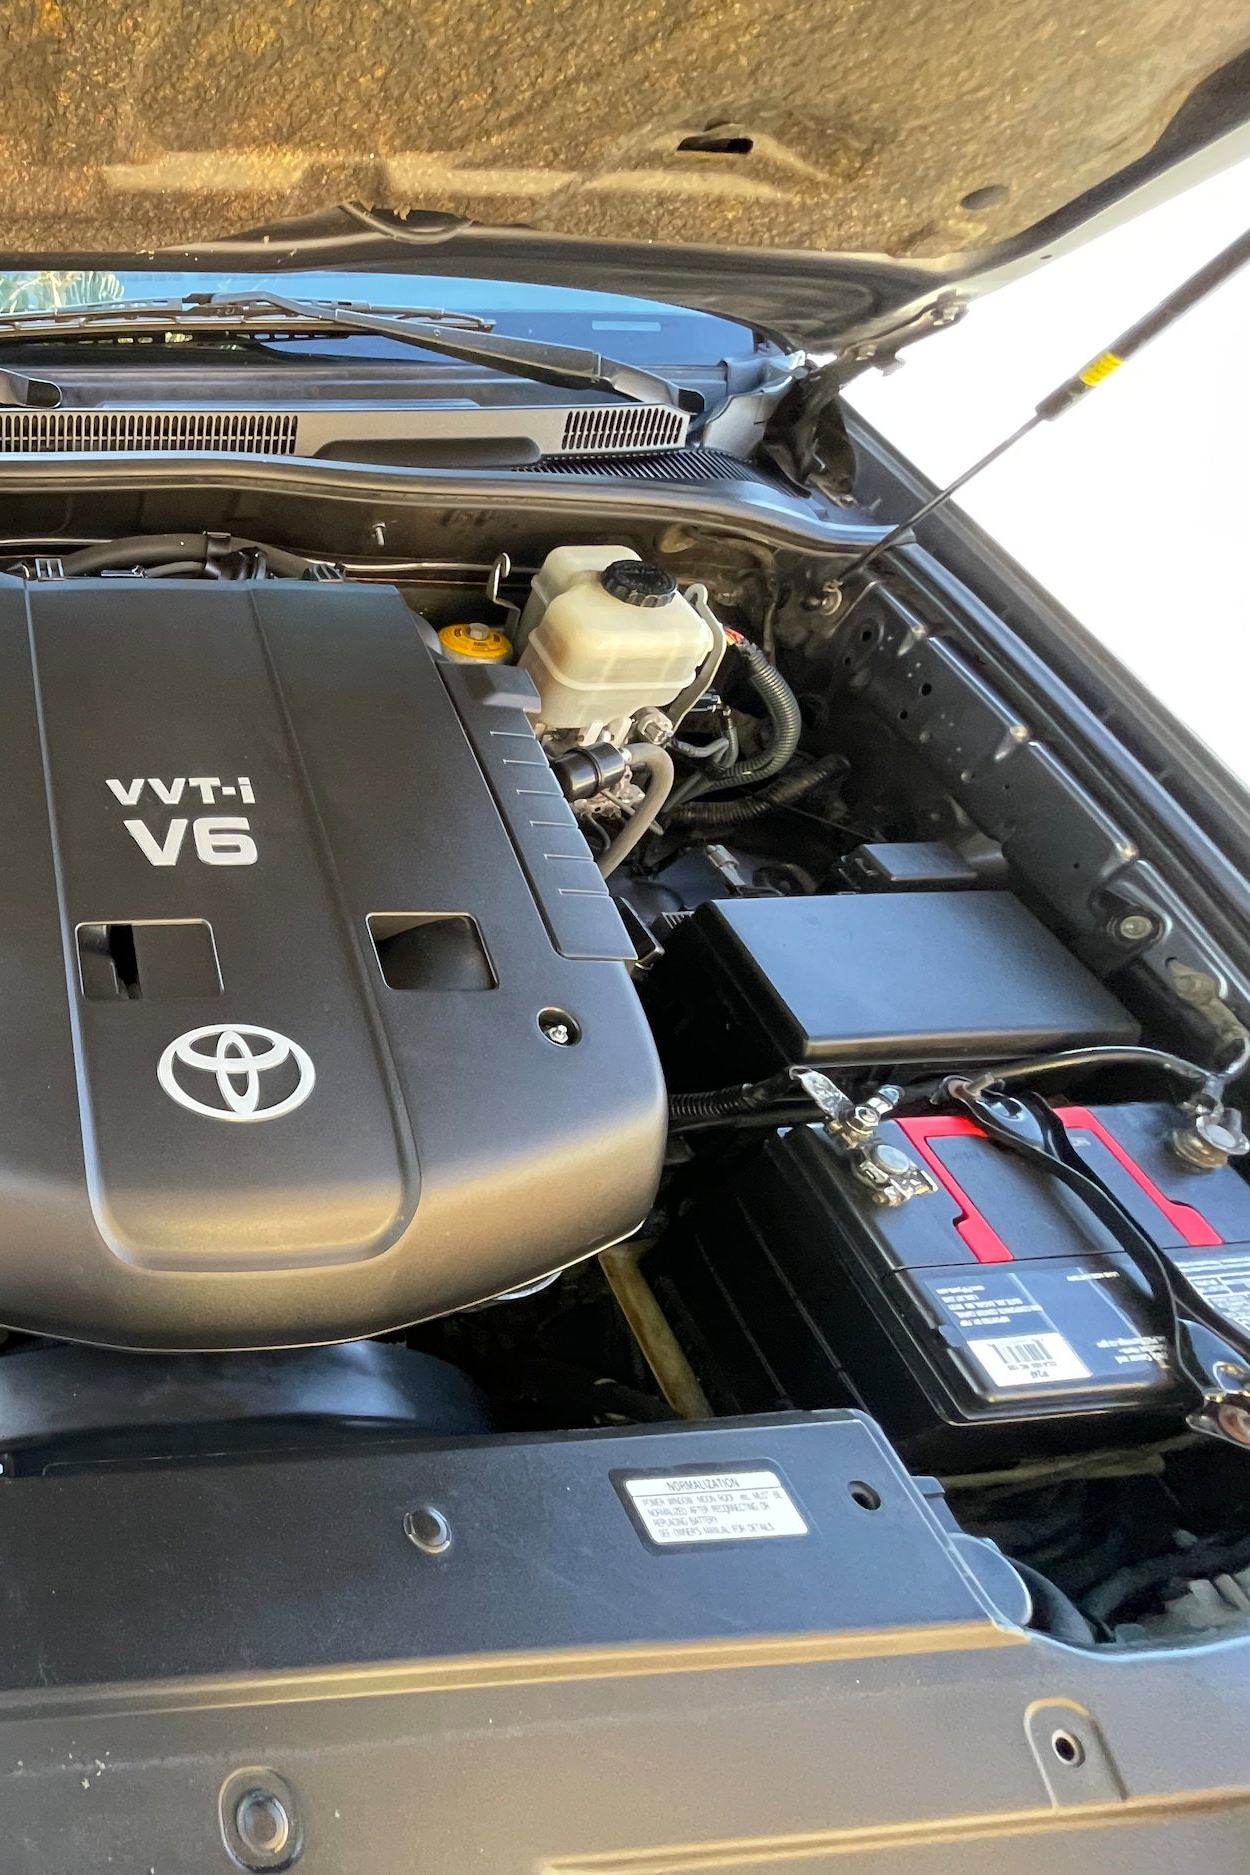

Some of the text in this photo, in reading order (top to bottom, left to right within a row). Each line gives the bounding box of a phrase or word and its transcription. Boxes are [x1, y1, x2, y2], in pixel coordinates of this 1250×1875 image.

[105, 776, 257, 806] VVT-i
[123, 817, 259, 866] V6
[666, 1477, 740, 1492] NORMALIZATION
[642, 1496, 665, 1507] POWER
[696, 1494, 717, 1503] MOON
[647, 1501, 771, 1518] NORMALIZED AFTER RECONNECTING OR
[658, 1528, 670, 1538] SEE
